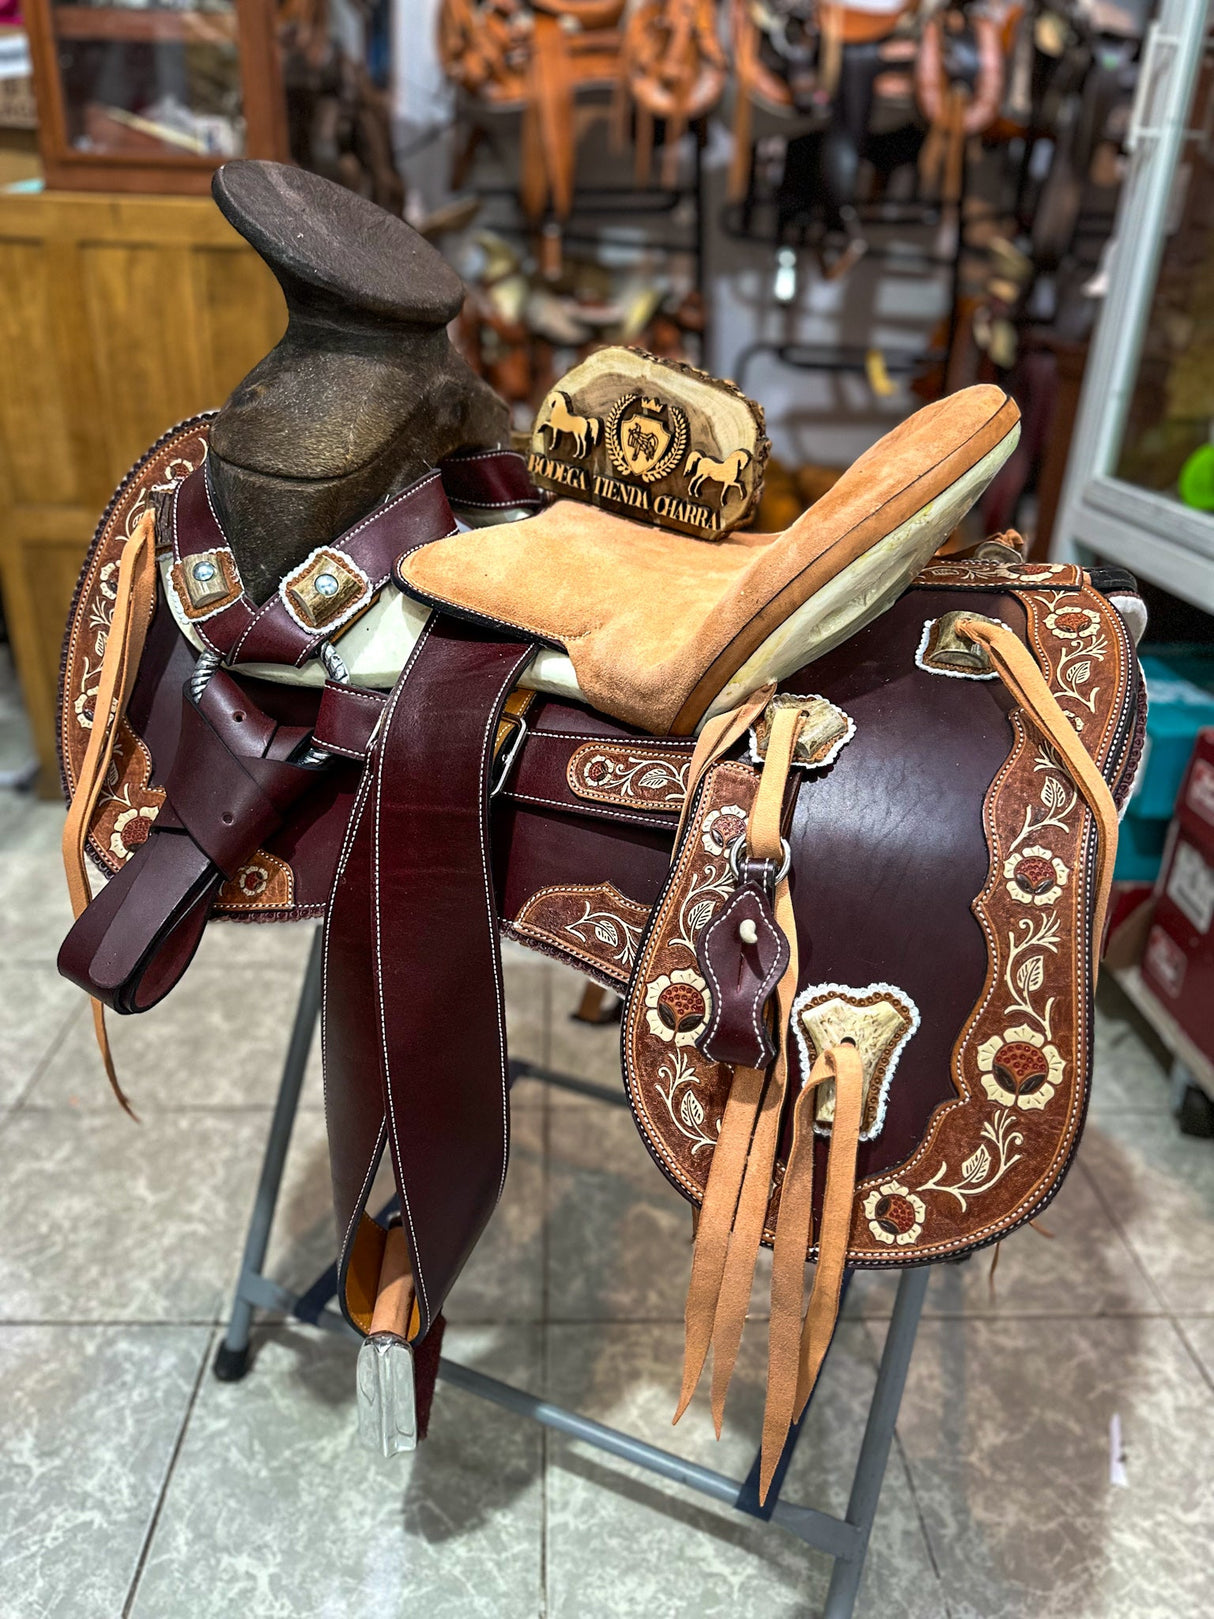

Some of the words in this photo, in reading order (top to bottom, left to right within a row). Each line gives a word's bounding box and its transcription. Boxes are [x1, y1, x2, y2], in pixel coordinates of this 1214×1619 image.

[527, 453, 587, 490] BODEGA
[593, 475, 649, 509] TIENDA
[653, 494, 718, 530] CHARRA
